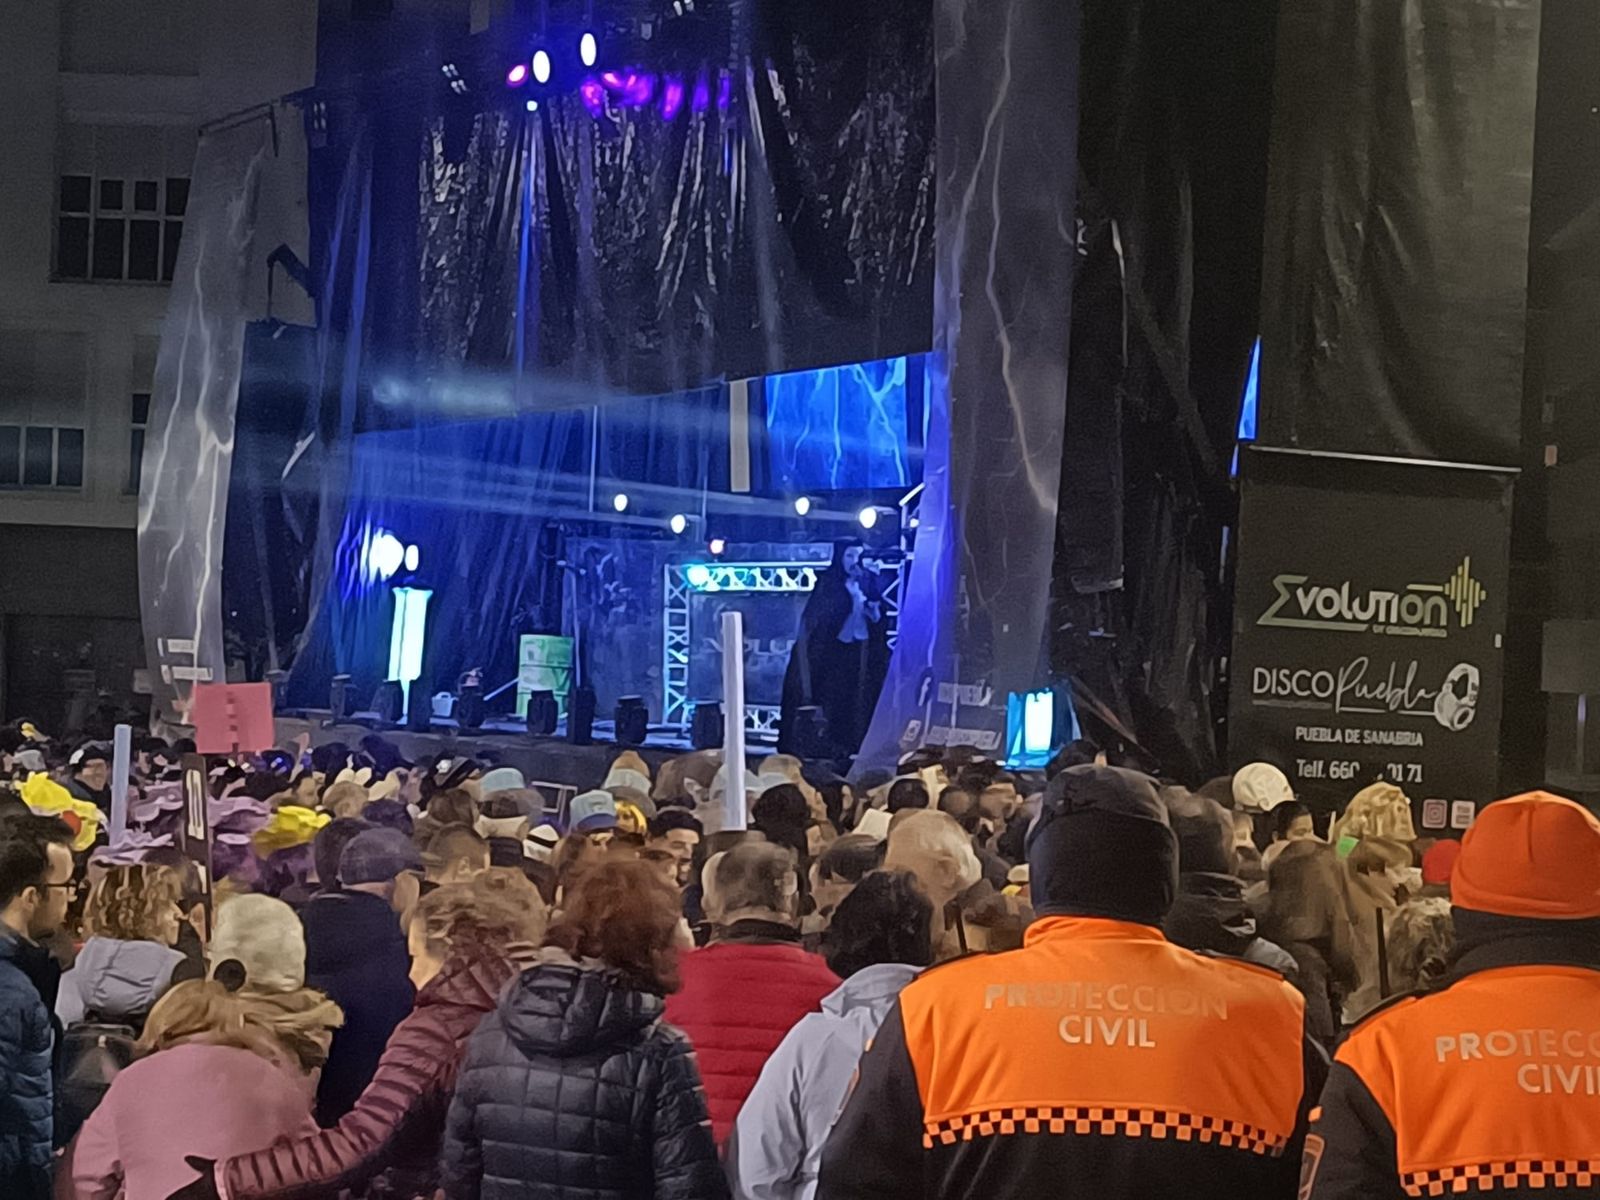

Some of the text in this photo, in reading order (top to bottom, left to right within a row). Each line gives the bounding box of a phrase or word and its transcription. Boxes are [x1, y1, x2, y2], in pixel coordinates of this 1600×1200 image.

[1295, 726, 1423, 747] PUEBLA DE SANABRIA
[1058, 1014, 1156, 1047] CIVIL
[1517, 1063, 1600, 1095] CIVI
